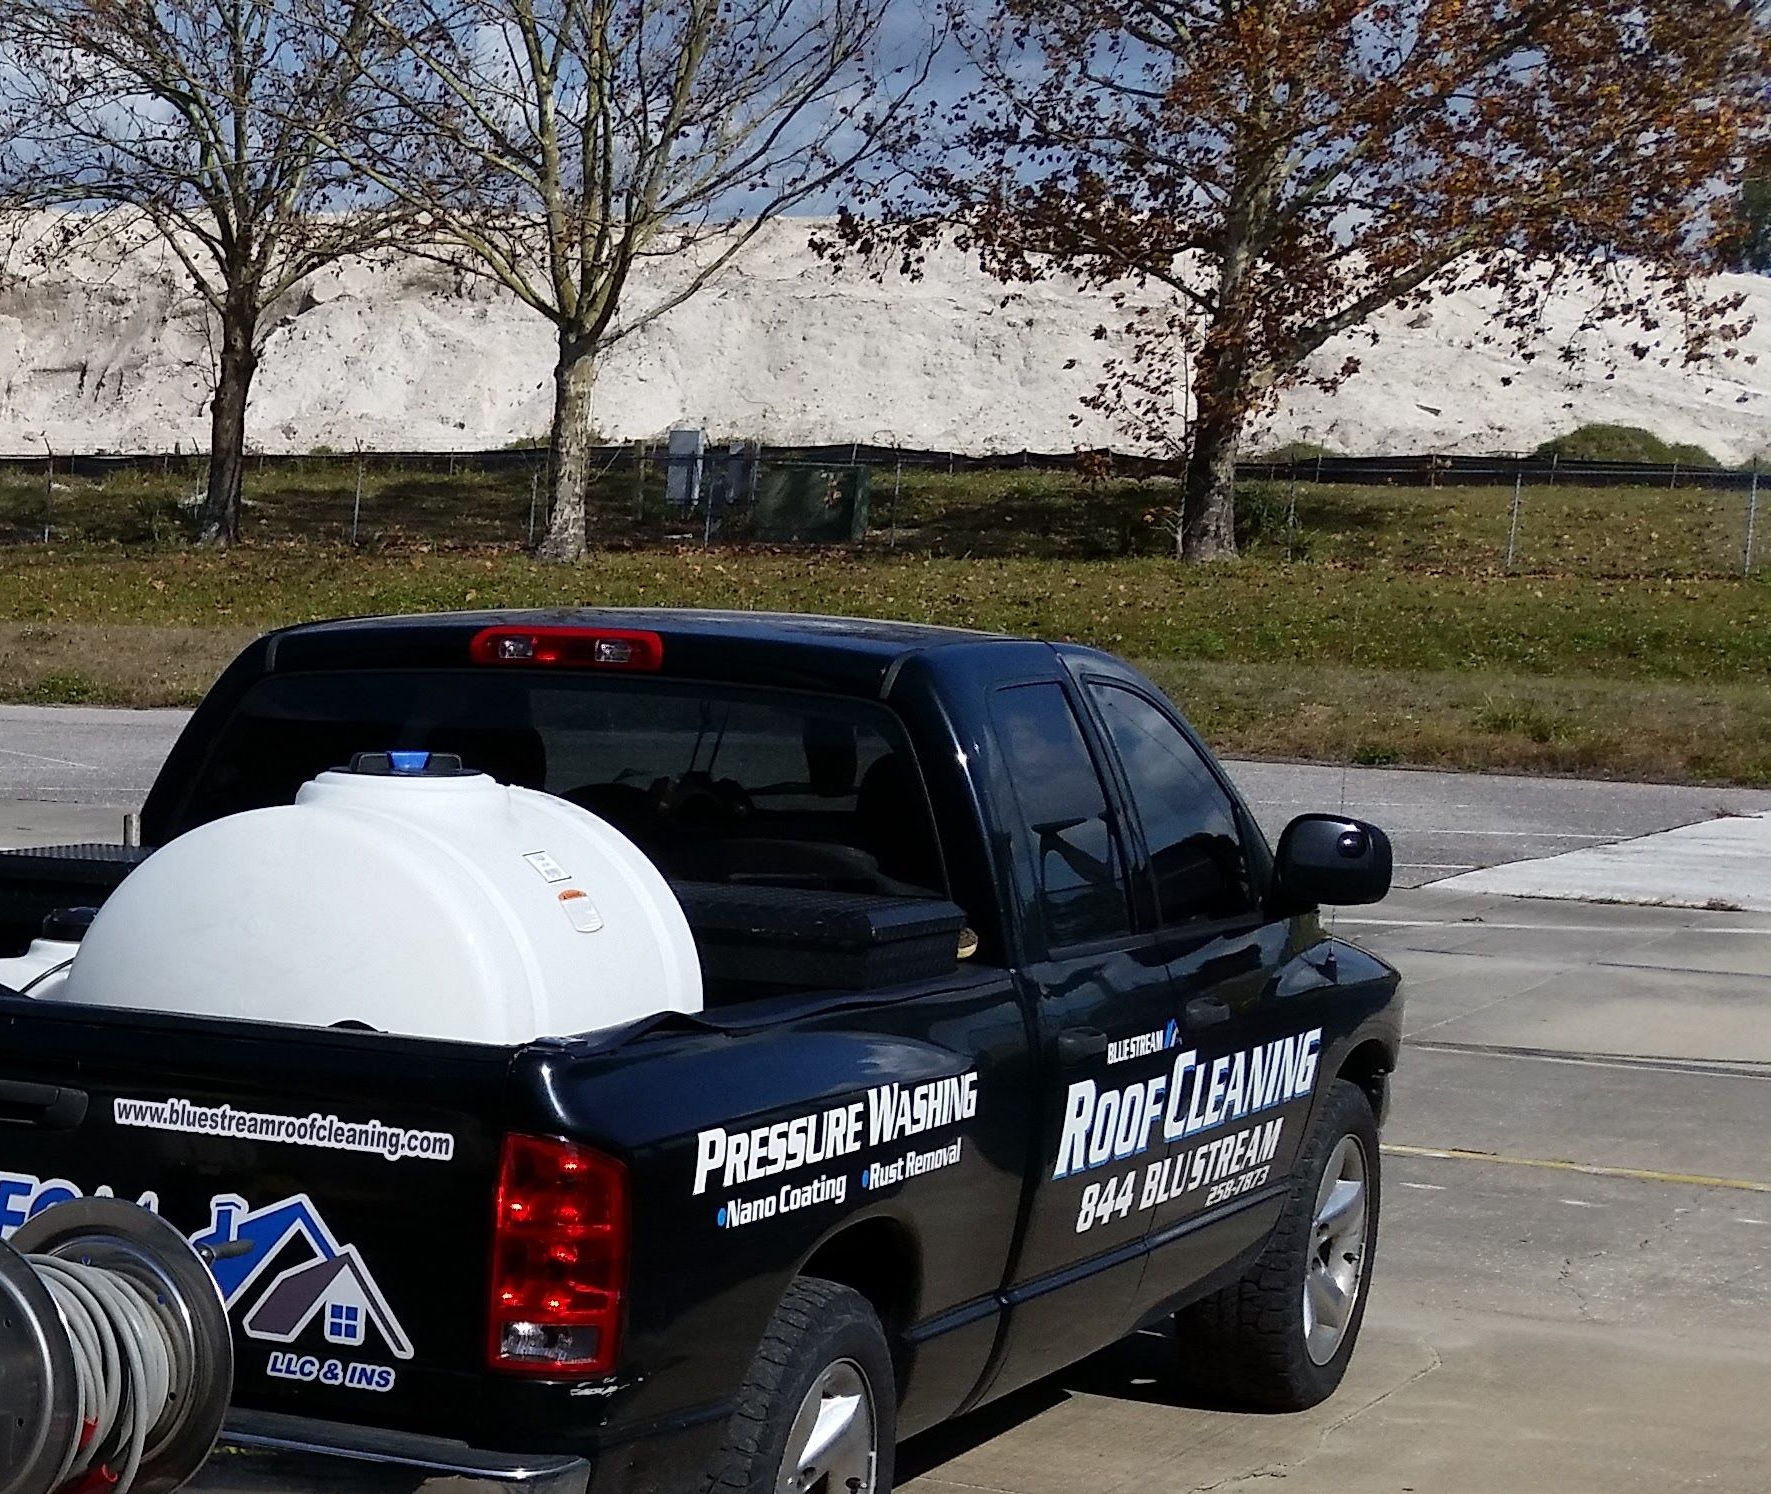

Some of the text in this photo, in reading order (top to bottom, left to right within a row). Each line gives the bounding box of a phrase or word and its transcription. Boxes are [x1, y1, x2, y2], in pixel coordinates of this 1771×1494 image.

[116, 1100, 452, 1157] www.bluestreamroofcleaning.com
[1052, 1027, 1322, 1180] ROOF CLEANING
[692, 1071, 978, 1195] PRESSURE WASHING
[869, 1137, 962, 1191] Rust Removal
[1205, 1165, 1270, 1207] 258-7873
[725, 1174, 847, 1229] Nano Coating
[1075, 1170, 1136, 1234] 844
[270, 1354, 393, 1388] LLC & INS
